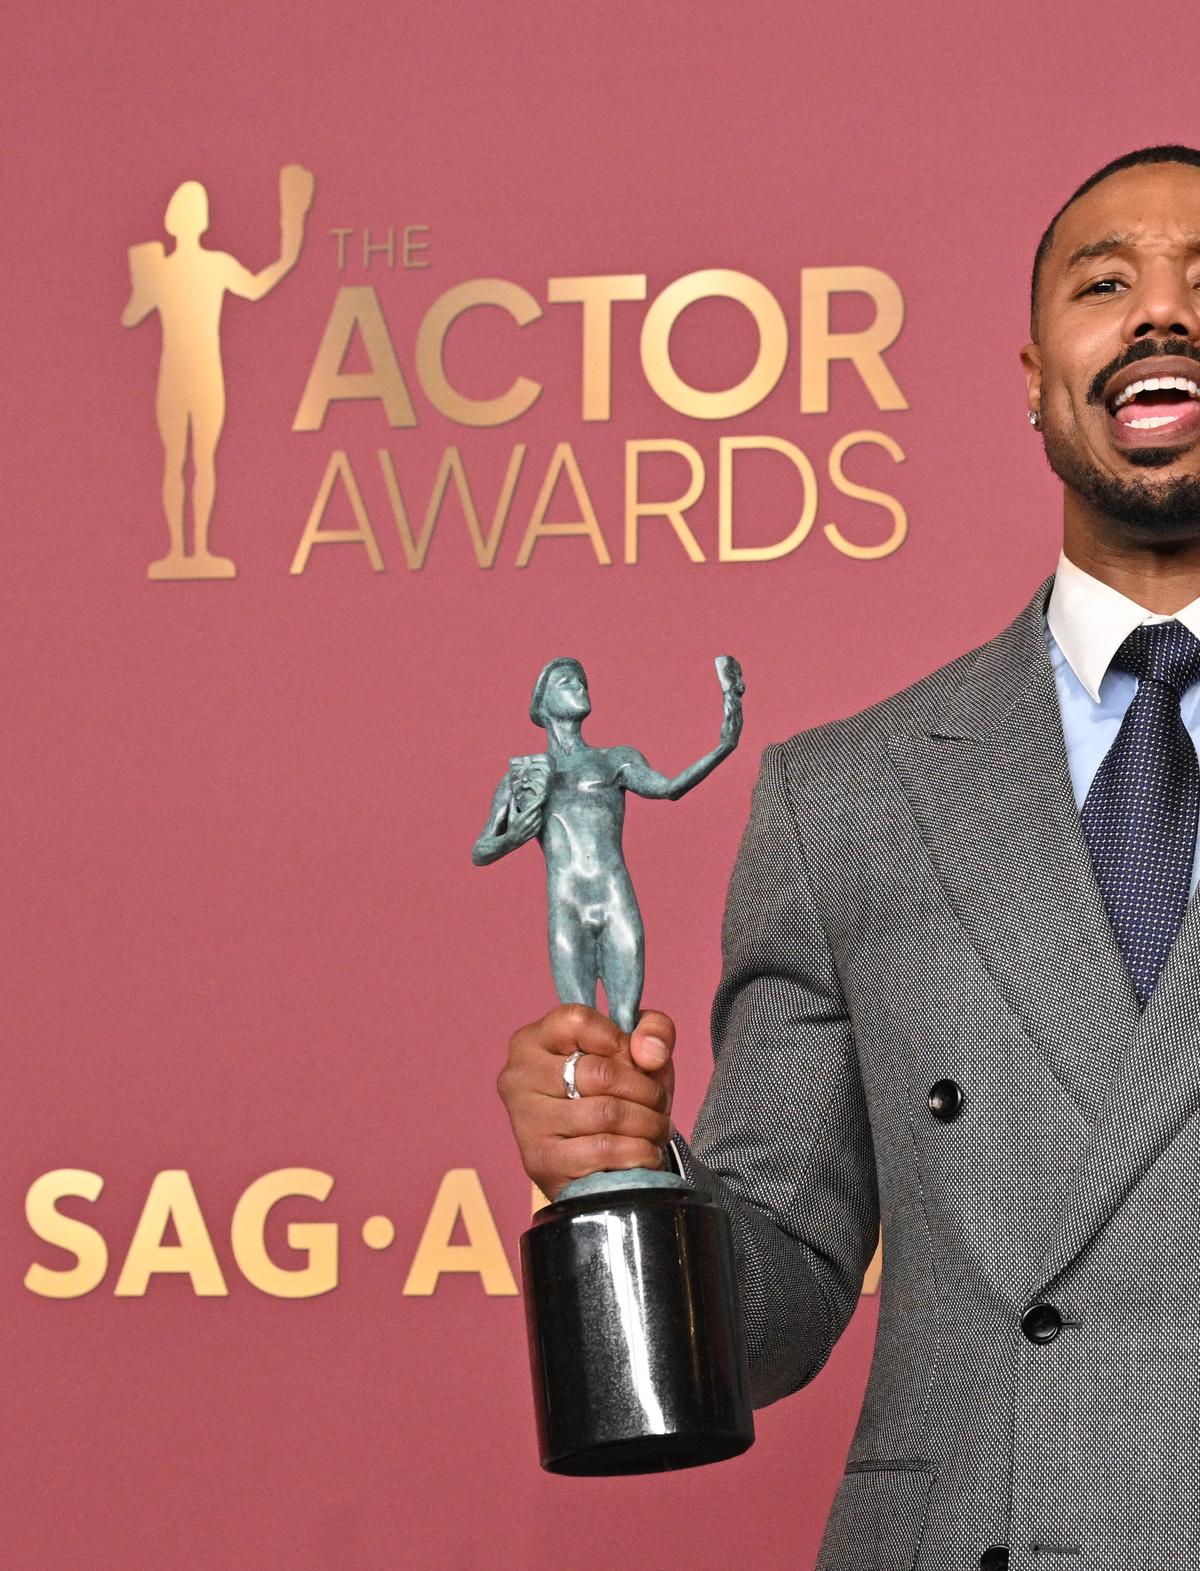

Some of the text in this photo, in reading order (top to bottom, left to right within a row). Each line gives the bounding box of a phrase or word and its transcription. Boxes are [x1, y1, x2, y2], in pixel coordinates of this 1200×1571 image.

[329, 226, 430, 270] THE
[292, 265, 911, 432] ACTOR
[289, 430, 909, 576] AWARDS
[23, 1167, 883, 1300] SAG·A
